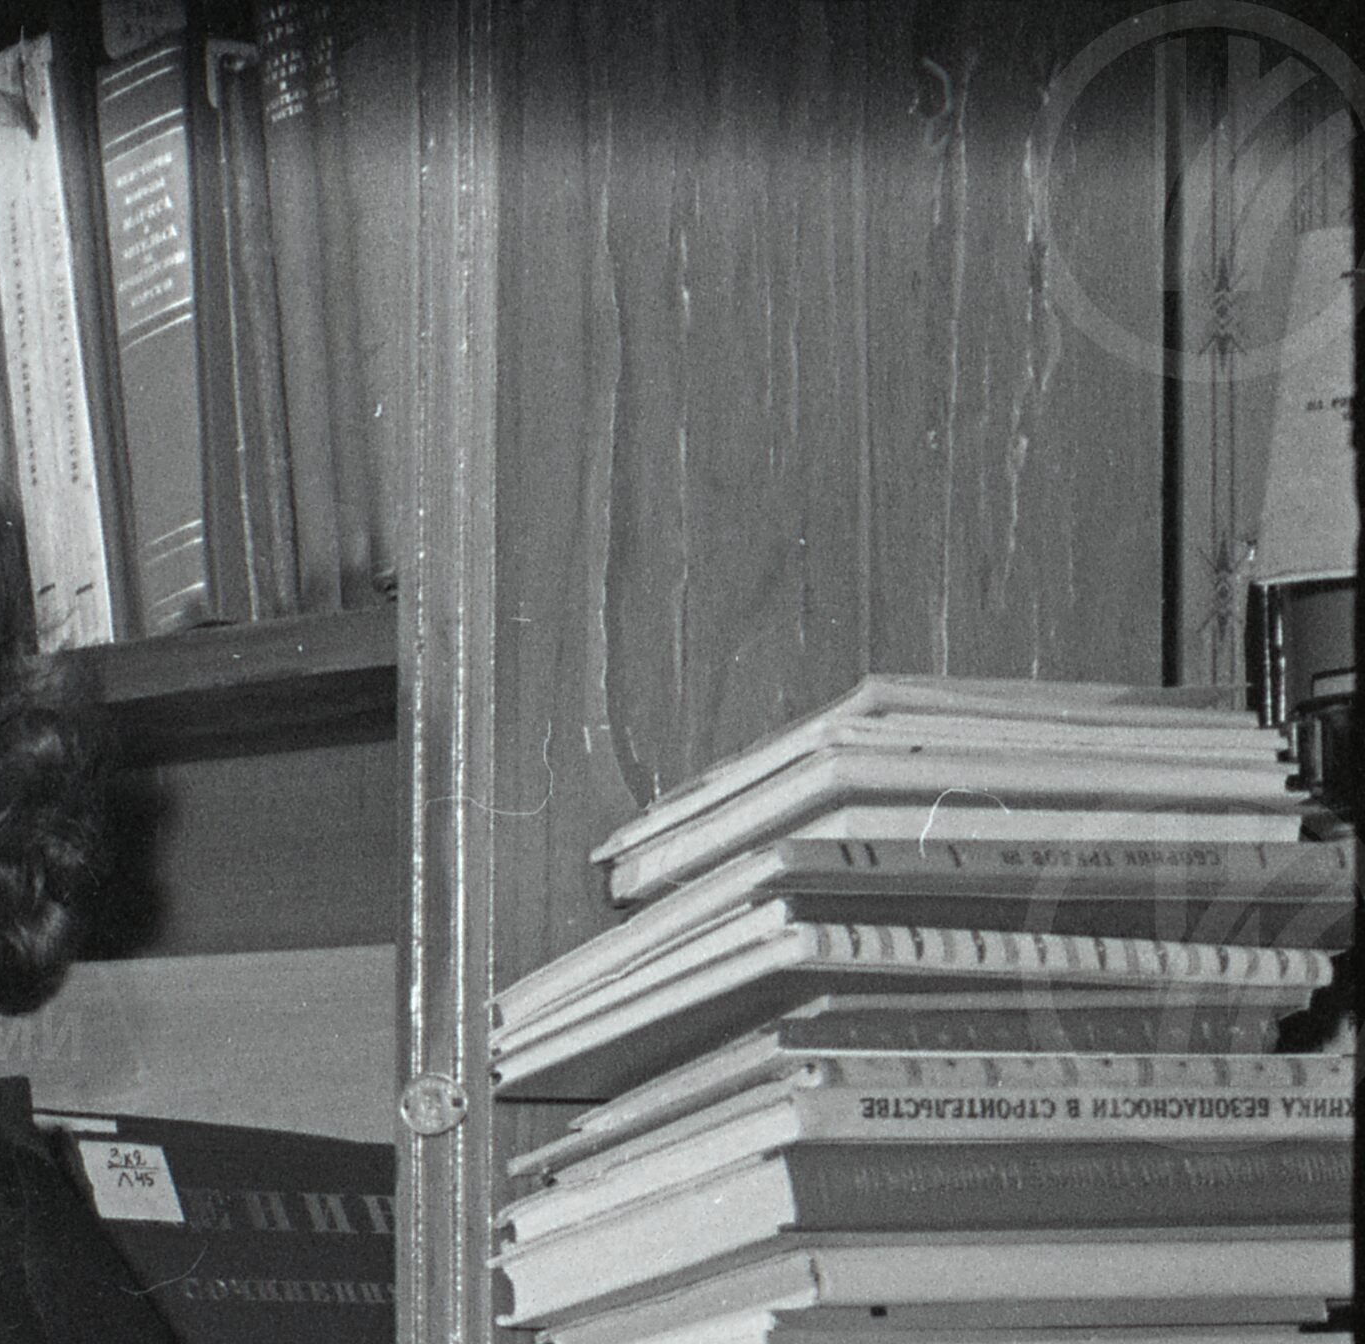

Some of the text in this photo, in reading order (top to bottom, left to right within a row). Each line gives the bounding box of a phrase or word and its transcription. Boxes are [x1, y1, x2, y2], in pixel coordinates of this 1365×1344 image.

[861, 1096, 1058, 1121] СТРОИТЕЛЬСТВЕ
[1069, 1096, 1082, 1118] В
[1092, 1095, 1269, 1119] БЕЗОПАСНОСТИ
[184, 1277, 395, 1303] СОЧИНЕНИ
